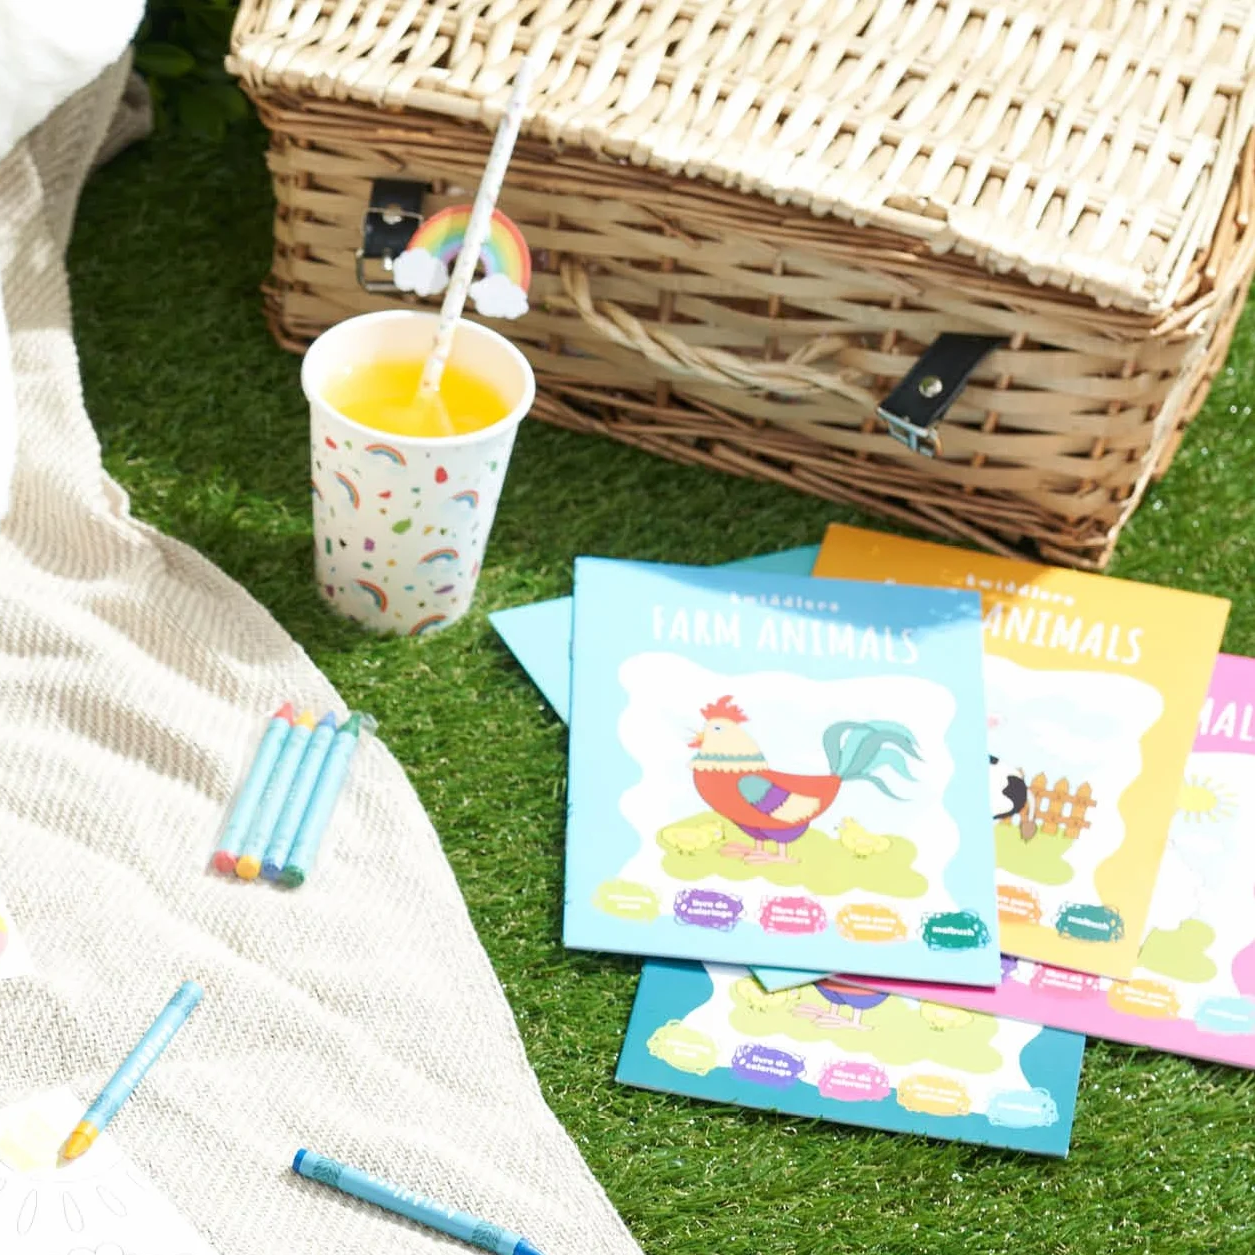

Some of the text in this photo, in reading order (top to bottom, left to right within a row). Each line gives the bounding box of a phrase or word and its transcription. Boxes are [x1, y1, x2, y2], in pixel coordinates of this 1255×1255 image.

[652, 604, 920, 664] FARM ANIMALS
[981, 602, 1144, 664] ANIMALS
